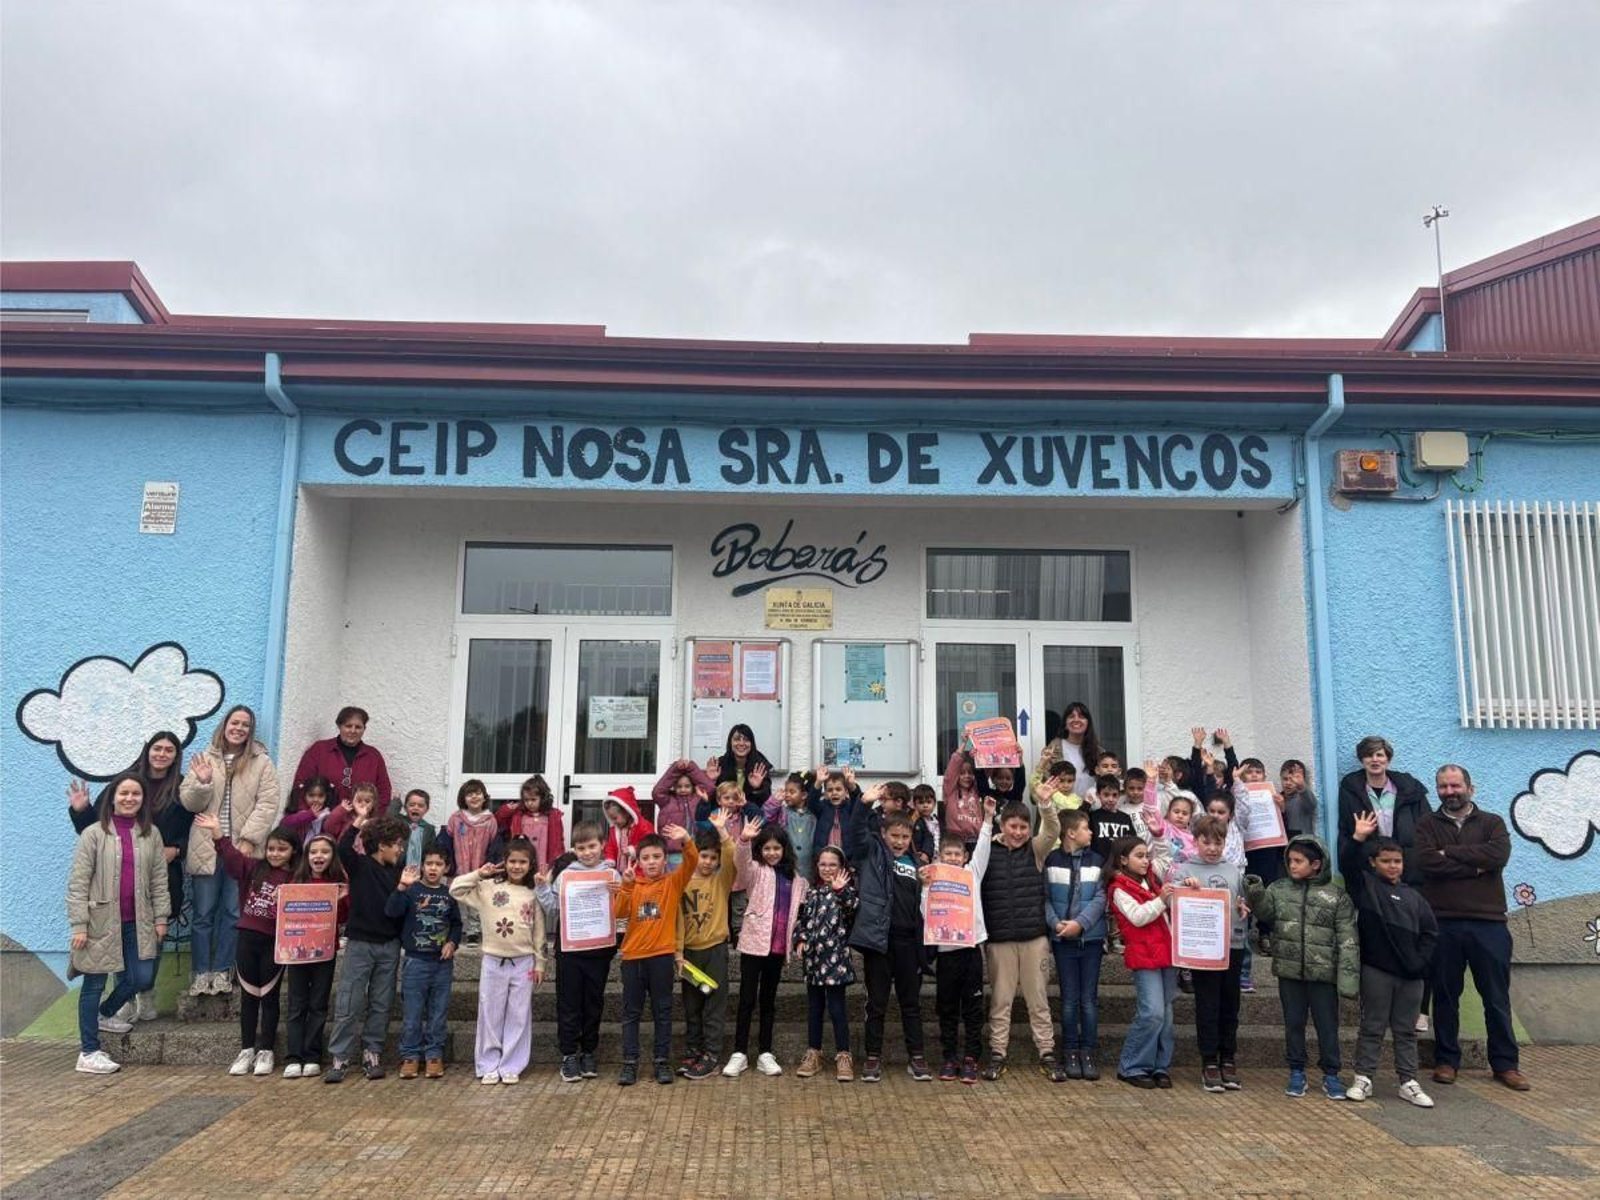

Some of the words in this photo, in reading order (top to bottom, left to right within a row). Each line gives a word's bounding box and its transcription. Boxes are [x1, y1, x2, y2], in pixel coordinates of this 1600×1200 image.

[334, 419, 497, 476] CEIP
[523, 425, 691, 485] NOSA
[718, 427, 844, 486] SRA.
[868, 432, 940, 485] DE
[976, 432, 1272, 491] XUVENCOS
[802, 601, 826, 609] GALICIA
